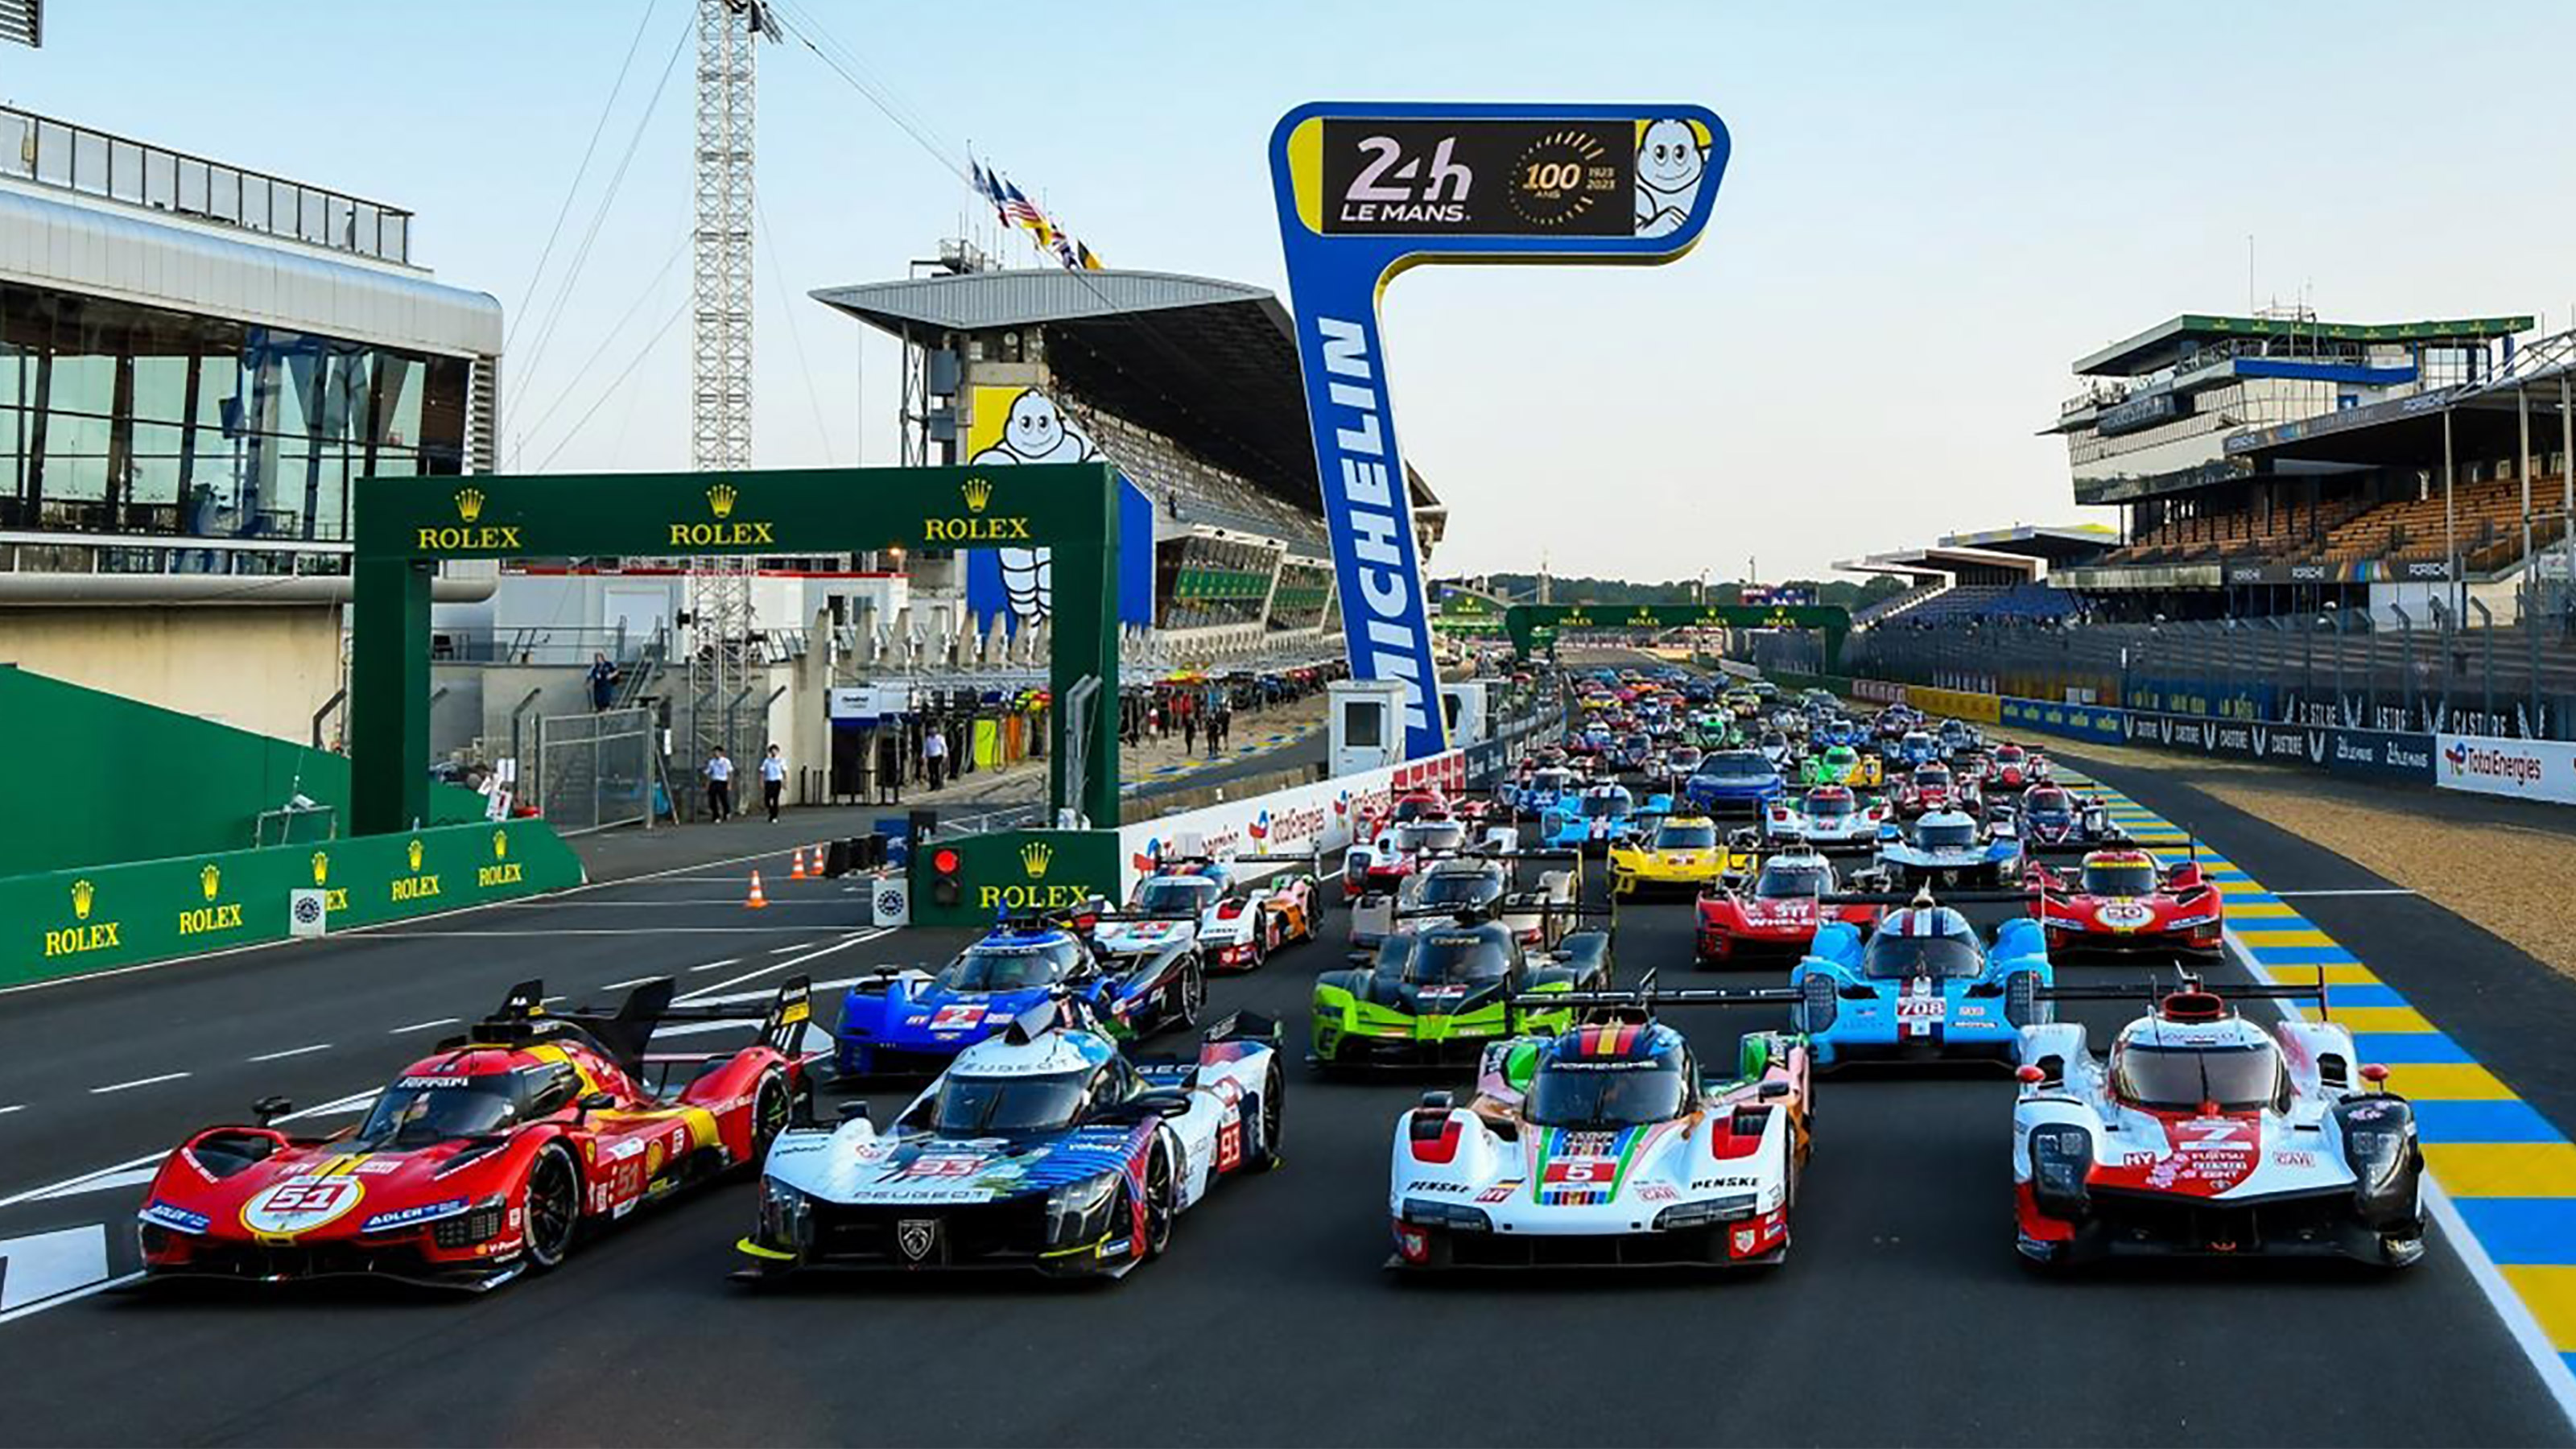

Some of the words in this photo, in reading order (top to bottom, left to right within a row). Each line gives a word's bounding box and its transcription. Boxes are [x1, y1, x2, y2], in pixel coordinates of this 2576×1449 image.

[1344, 136, 1474, 201] 24h
[1522, 163, 1581, 190] 100
[1340, 205, 1377, 221] LE
[1381, 204, 1465, 223] MANS
[669, 522, 775, 546] ROLEX
[923, 517, 1031, 540] ROLEX
[1318, 316, 1428, 731] MICHELIN
[418, 526, 522, 550] ROLEX
[2468, 748, 2541, 786] TotalEnergies
[478, 862, 522, 886] ROLEX
[392, 874, 440, 902] ROLEX
[980, 885, 1091, 909] ROLEX
[179, 905, 243, 935] ROLEX
[44, 922, 120, 956] ROLEX
[1902, 1001, 1945, 1016] 708
[2189, 1127, 2237, 1140] 7
[2125, 1153, 2153, 1166] HY
[1565, 1163, 1595, 1181] 5
[1691, 1176, 1760, 1190] PENSKE
[267, 1187, 336, 1208] 51
[853, 1190, 989, 1199] PEUGEOT
[1407, 1180, 1472, 1193] PENSKE
[369, 1208, 423, 1225] ADLER
